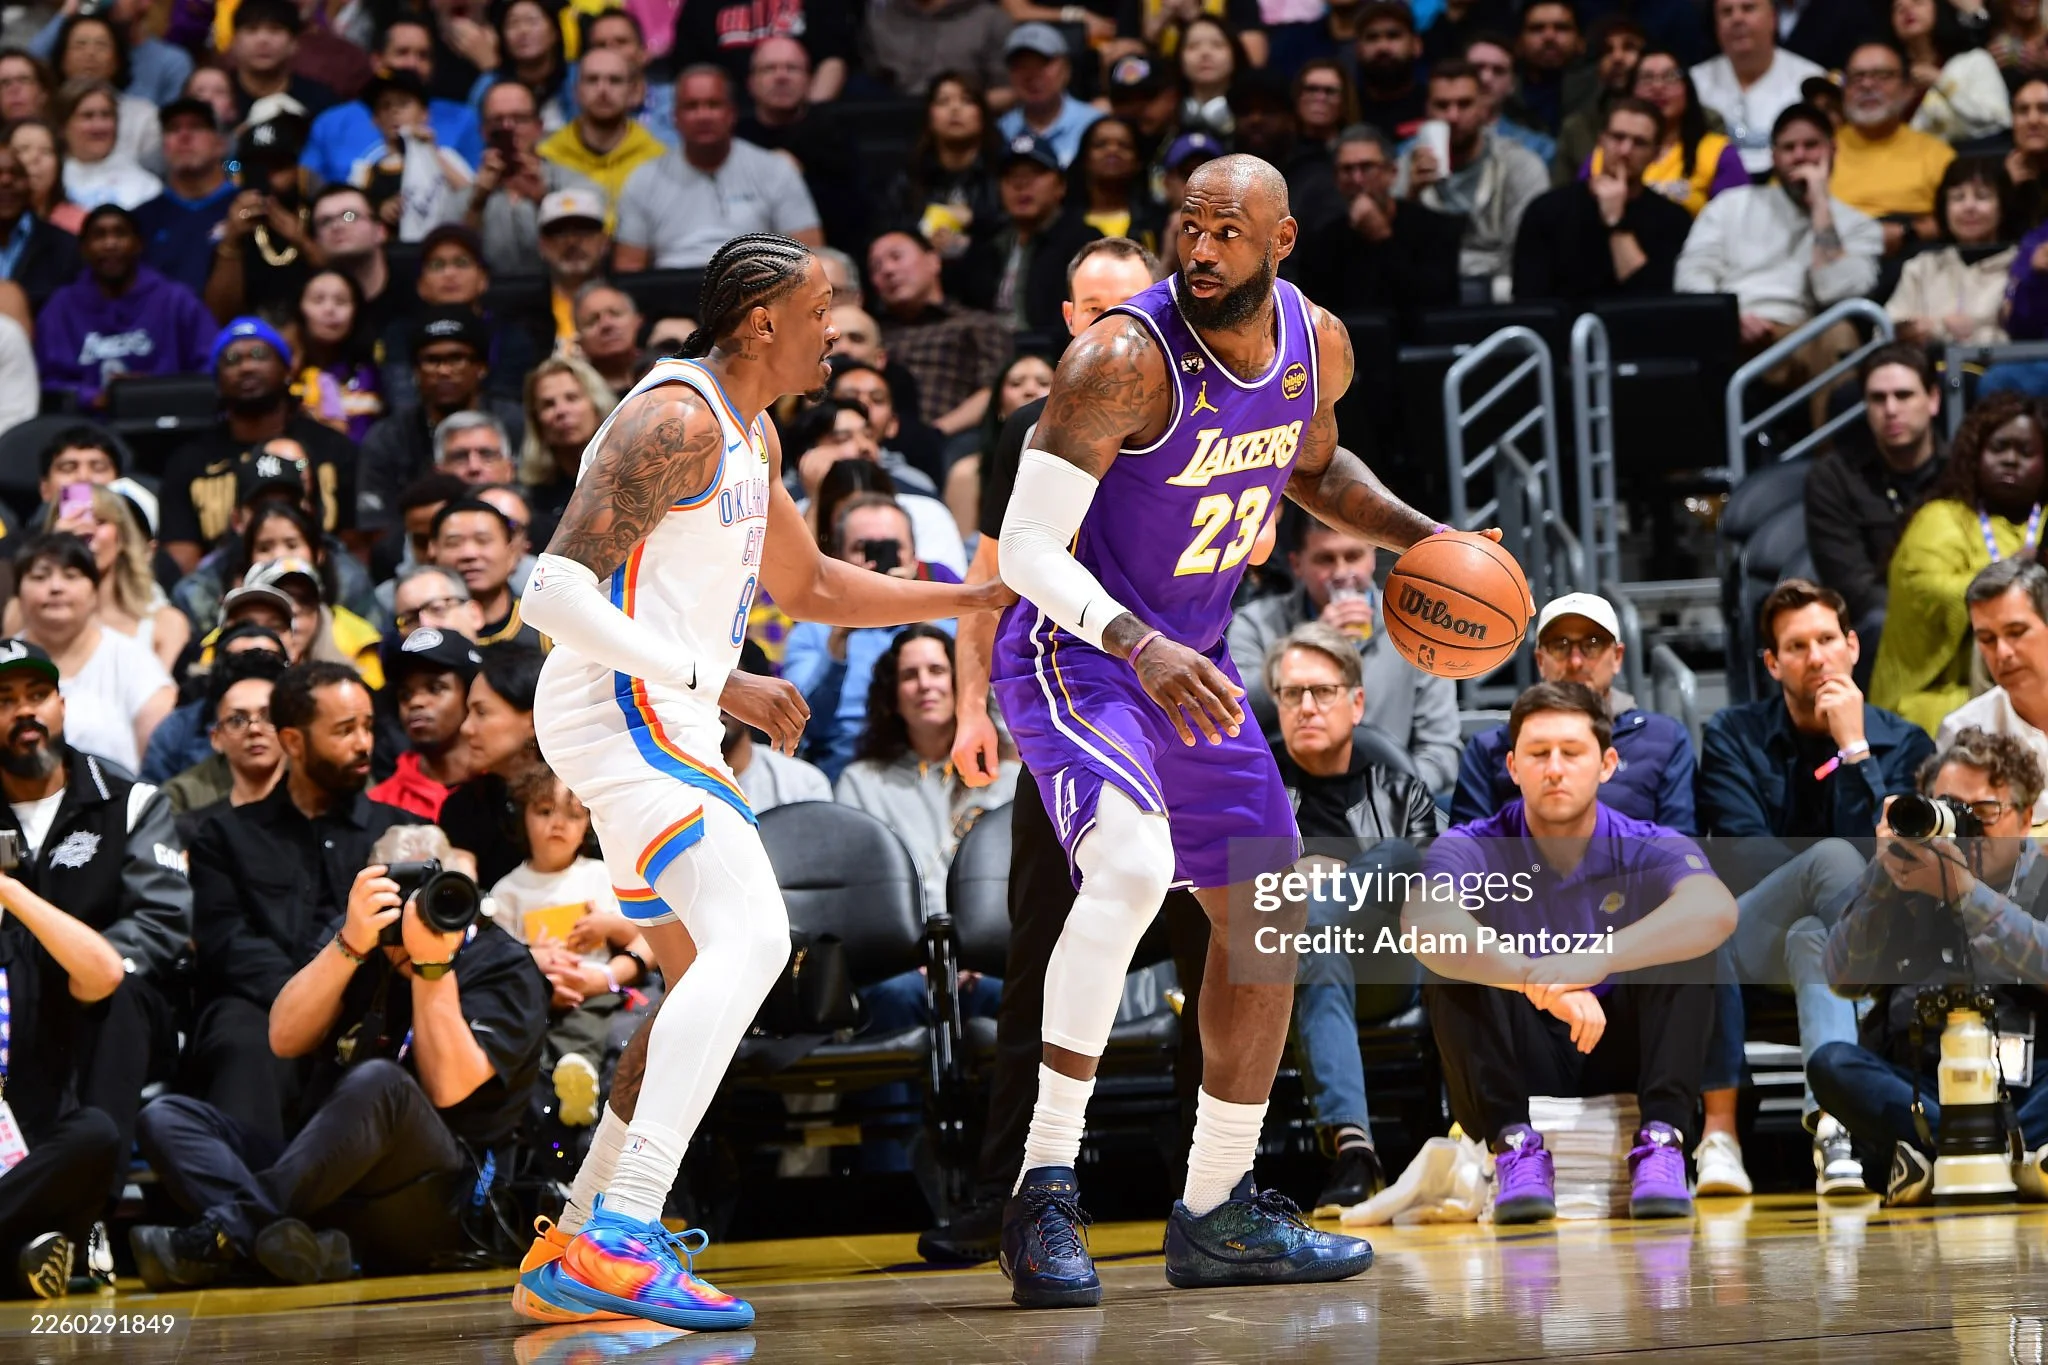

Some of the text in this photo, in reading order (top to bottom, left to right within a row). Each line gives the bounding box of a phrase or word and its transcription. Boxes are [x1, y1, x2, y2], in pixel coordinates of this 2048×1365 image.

[1165, 420, 1304, 487] LAKERS
[1173, 485, 1272, 577] 23
[730, 573, 758, 648] 8
[1399, 582, 1487, 640] Wilson
[1052, 766, 1080, 843] LA
